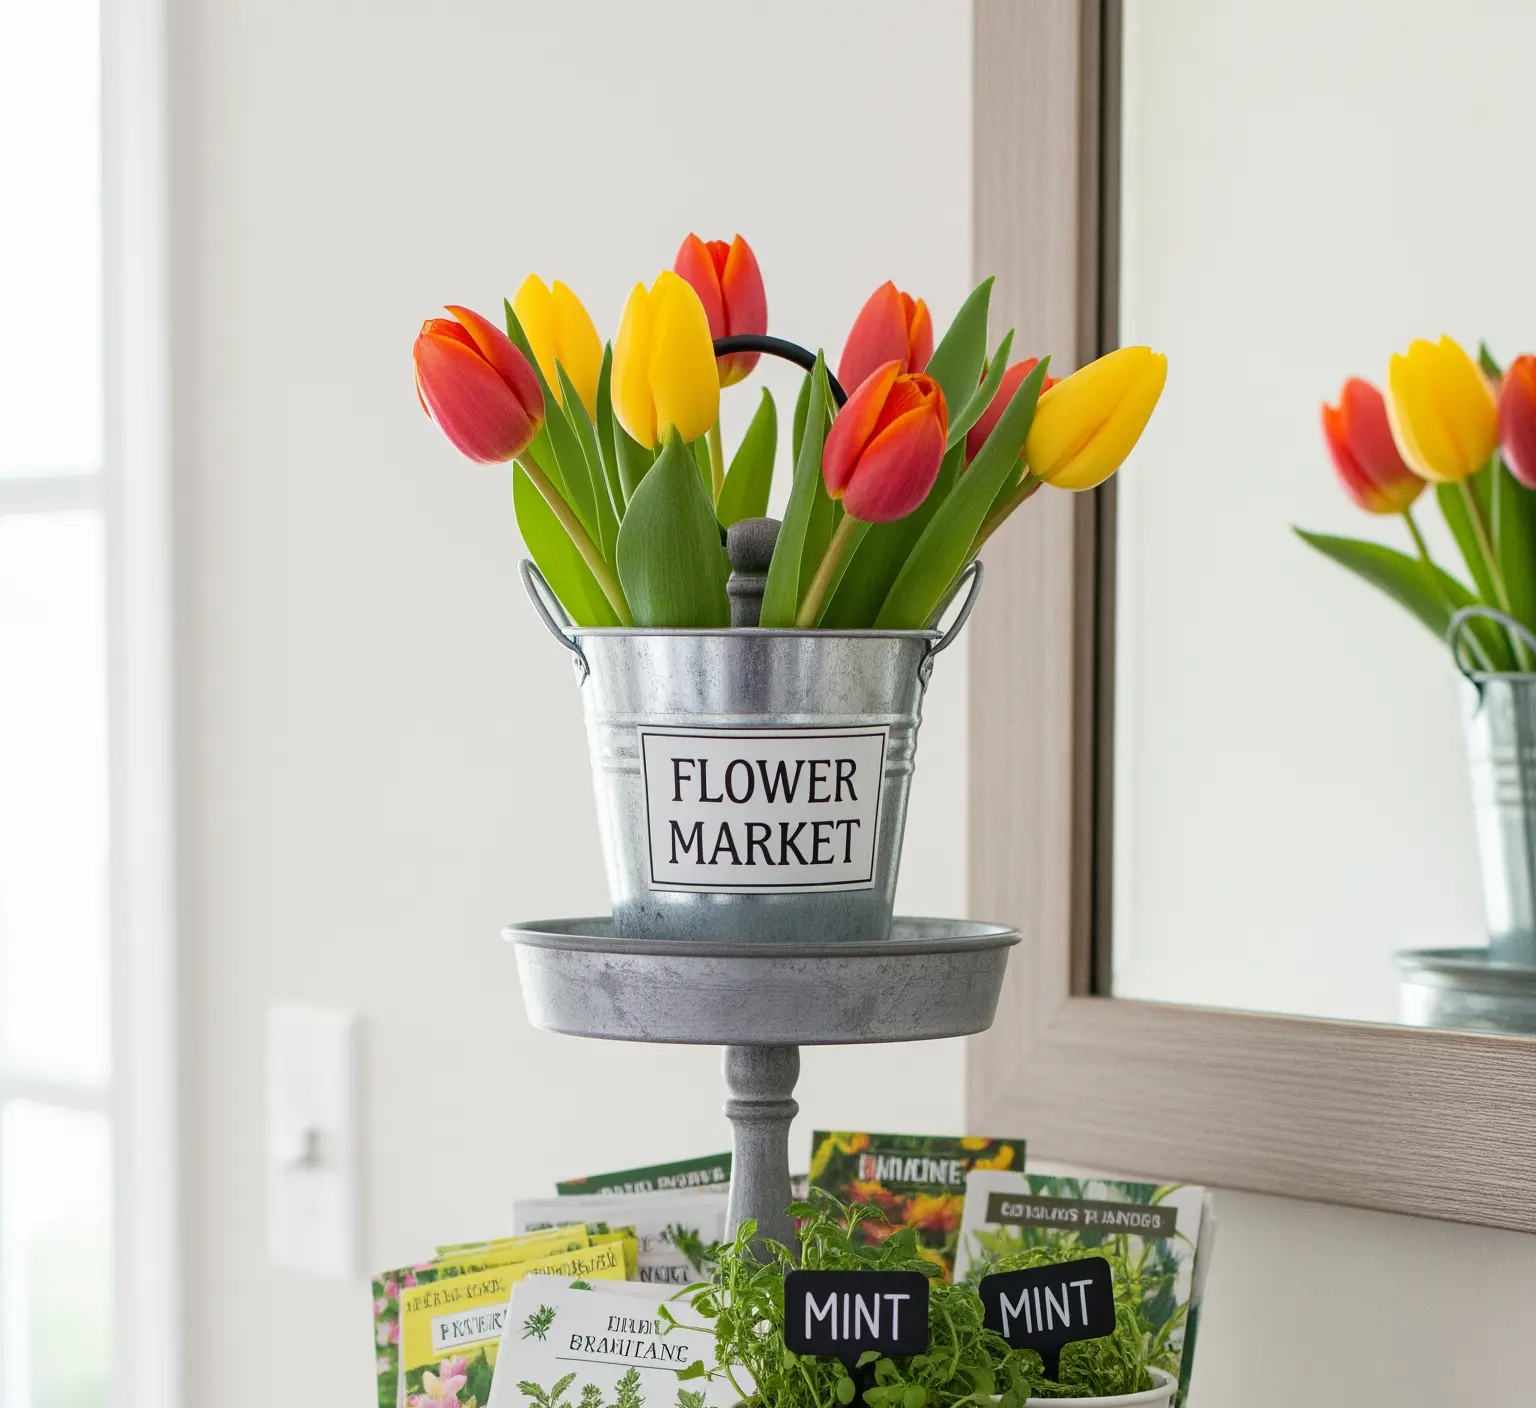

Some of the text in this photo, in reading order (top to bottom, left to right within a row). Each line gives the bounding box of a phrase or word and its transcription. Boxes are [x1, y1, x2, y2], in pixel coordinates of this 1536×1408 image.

[671, 758, 858, 804] FLOWER
[668, 818, 861, 866] MARKET
[804, 1292, 911, 1341] MINT
[1000, 1279, 1093, 1339] MINT
